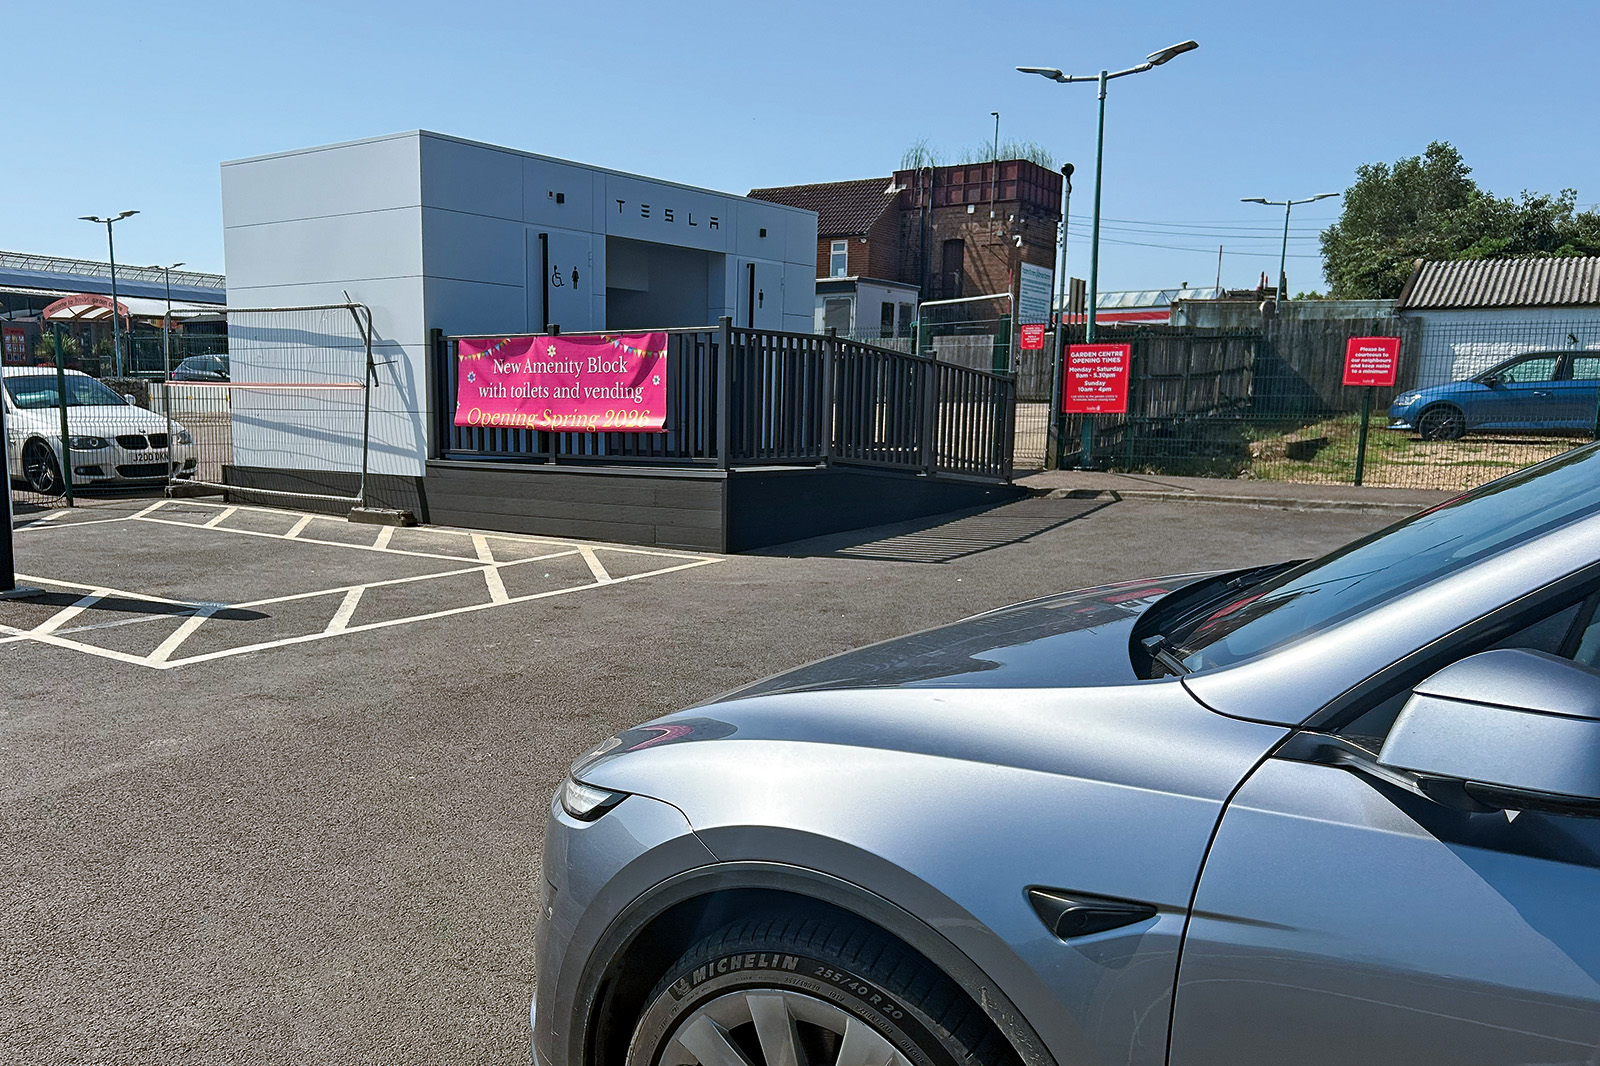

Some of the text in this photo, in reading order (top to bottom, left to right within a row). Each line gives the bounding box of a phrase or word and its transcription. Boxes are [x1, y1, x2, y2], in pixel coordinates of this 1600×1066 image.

[616, 199, 719, 230] TESLA
[49, 301, 67, 313] welcome
[108, 301, 123, 311] cere
[493, 356, 628, 378] New Amenity Block
[478, 382, 644, 404] with toilets and vending
[467, 407, 651, 432] Opening Spring 2026
[133, 452, 154, 462] J200
[692, 954, 800, 986] MICHELIN
[814, 966, 903, 1020] 255/40 R 20
